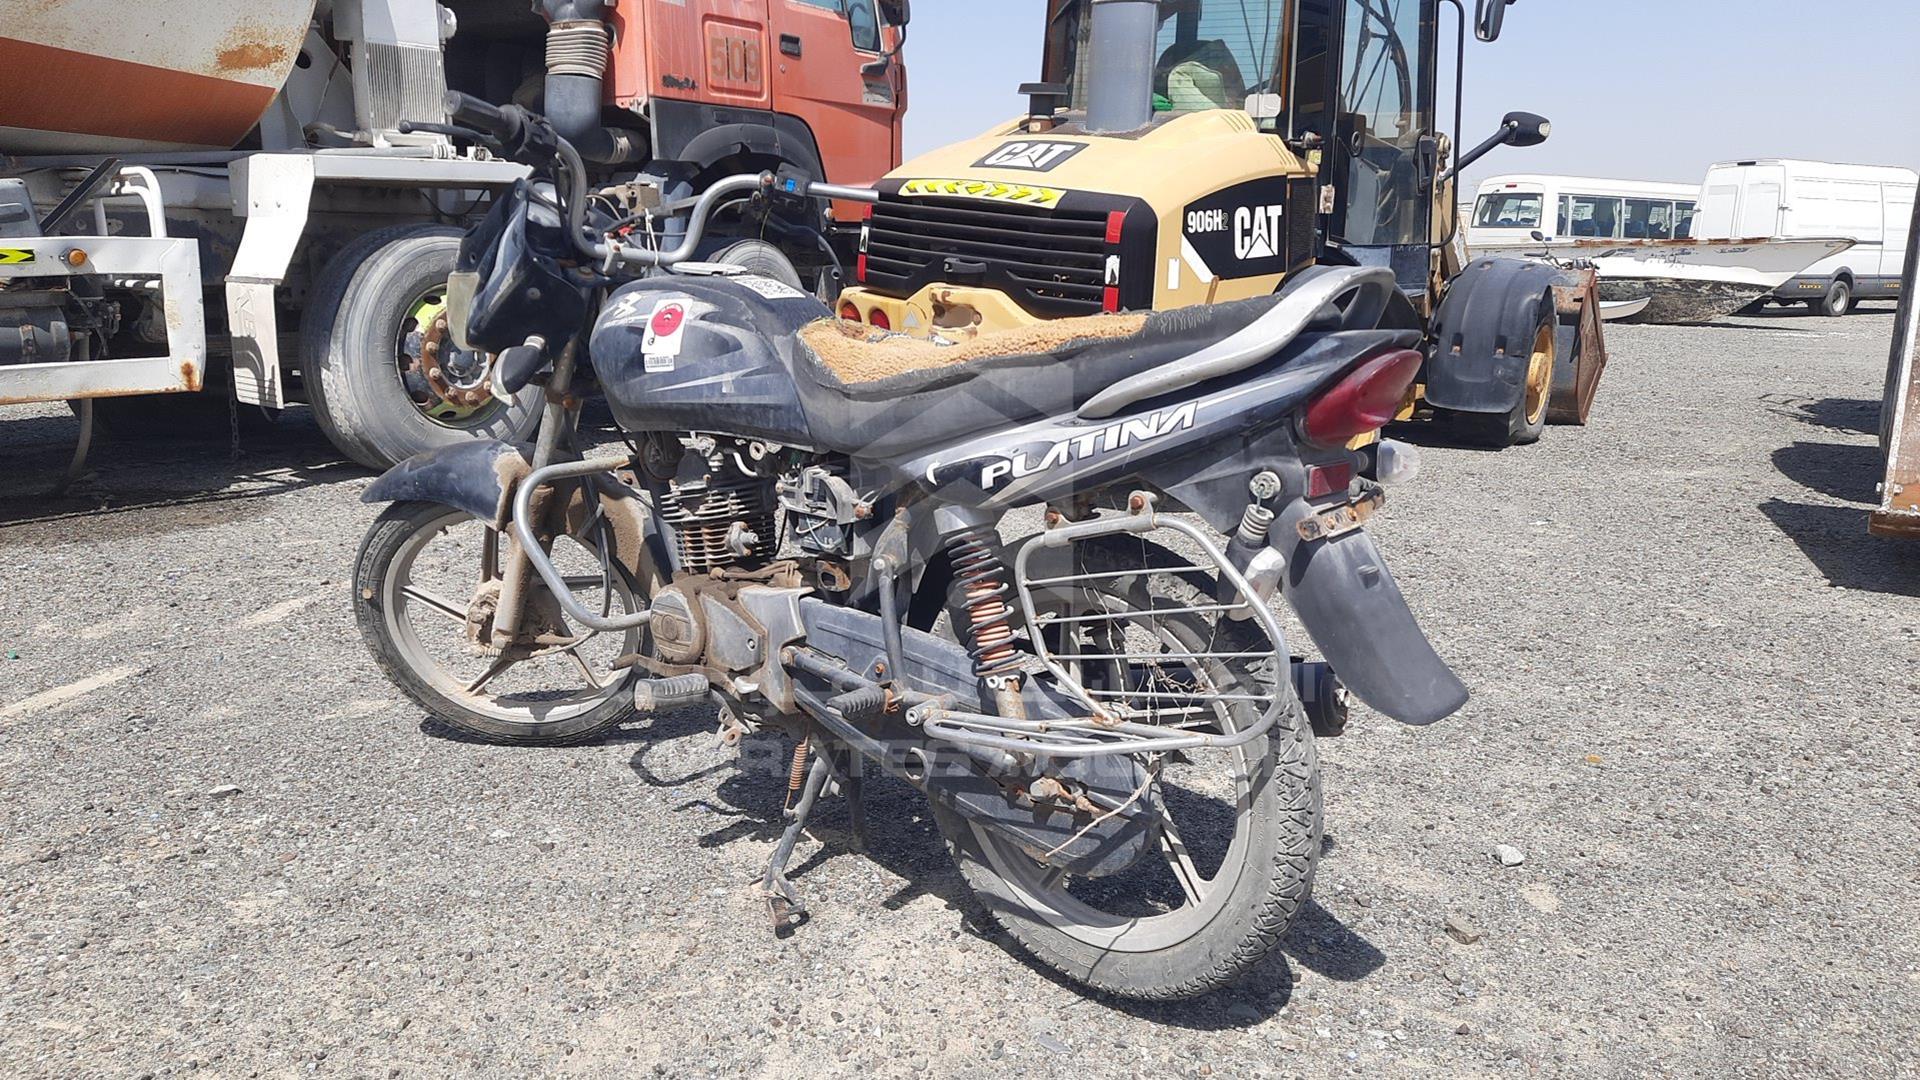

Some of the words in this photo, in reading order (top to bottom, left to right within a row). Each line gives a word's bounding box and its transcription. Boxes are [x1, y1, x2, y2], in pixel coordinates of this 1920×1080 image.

[711, 37, 760, 82] 509
[984, 142, 1077, 168] CAT
[1234, 204, 1283, 260] CAT
[980, 400, 1199, 491] PLATINA
